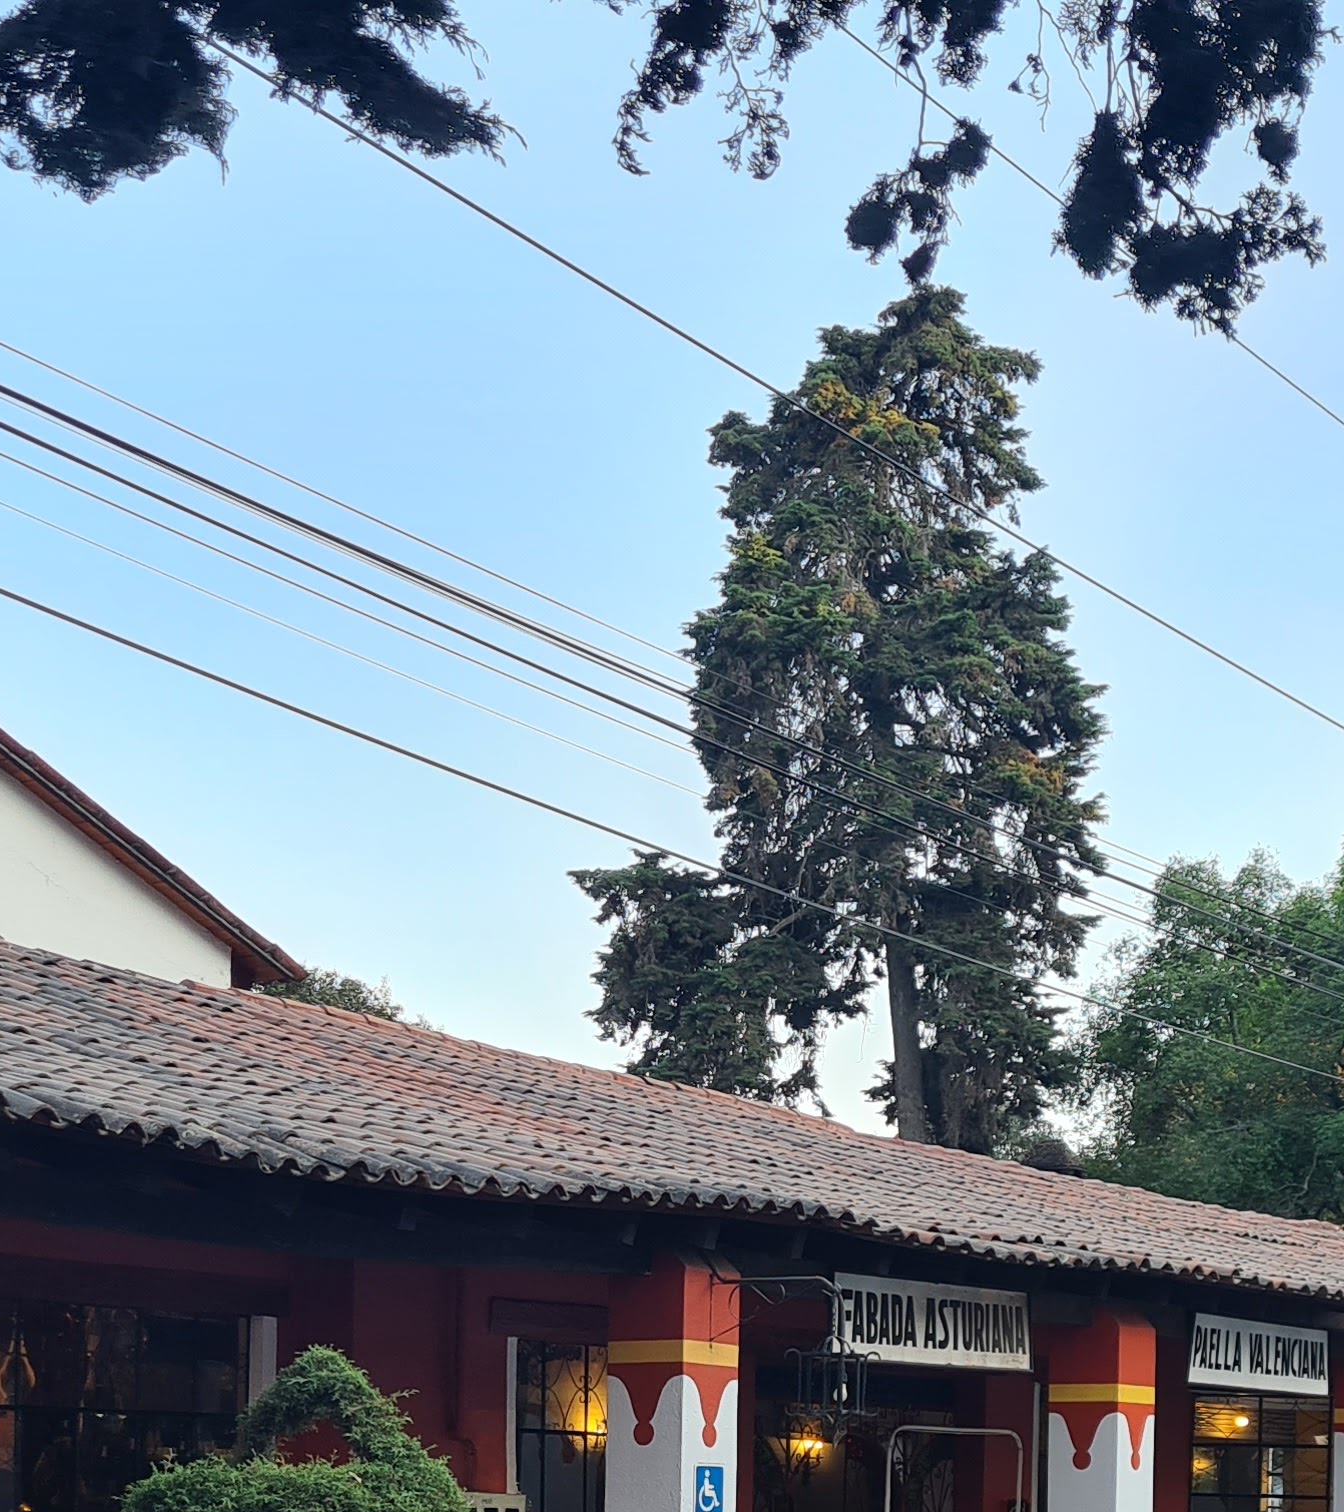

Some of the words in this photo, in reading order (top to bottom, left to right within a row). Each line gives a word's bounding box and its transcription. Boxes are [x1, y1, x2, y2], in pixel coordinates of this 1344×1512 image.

[924, 1297, 1027, 1354] ASTURIANA
[1193, 1325, 1242, 1373] PAELLA
[1249, 1332, 1326, 1380] VALENCIANA
